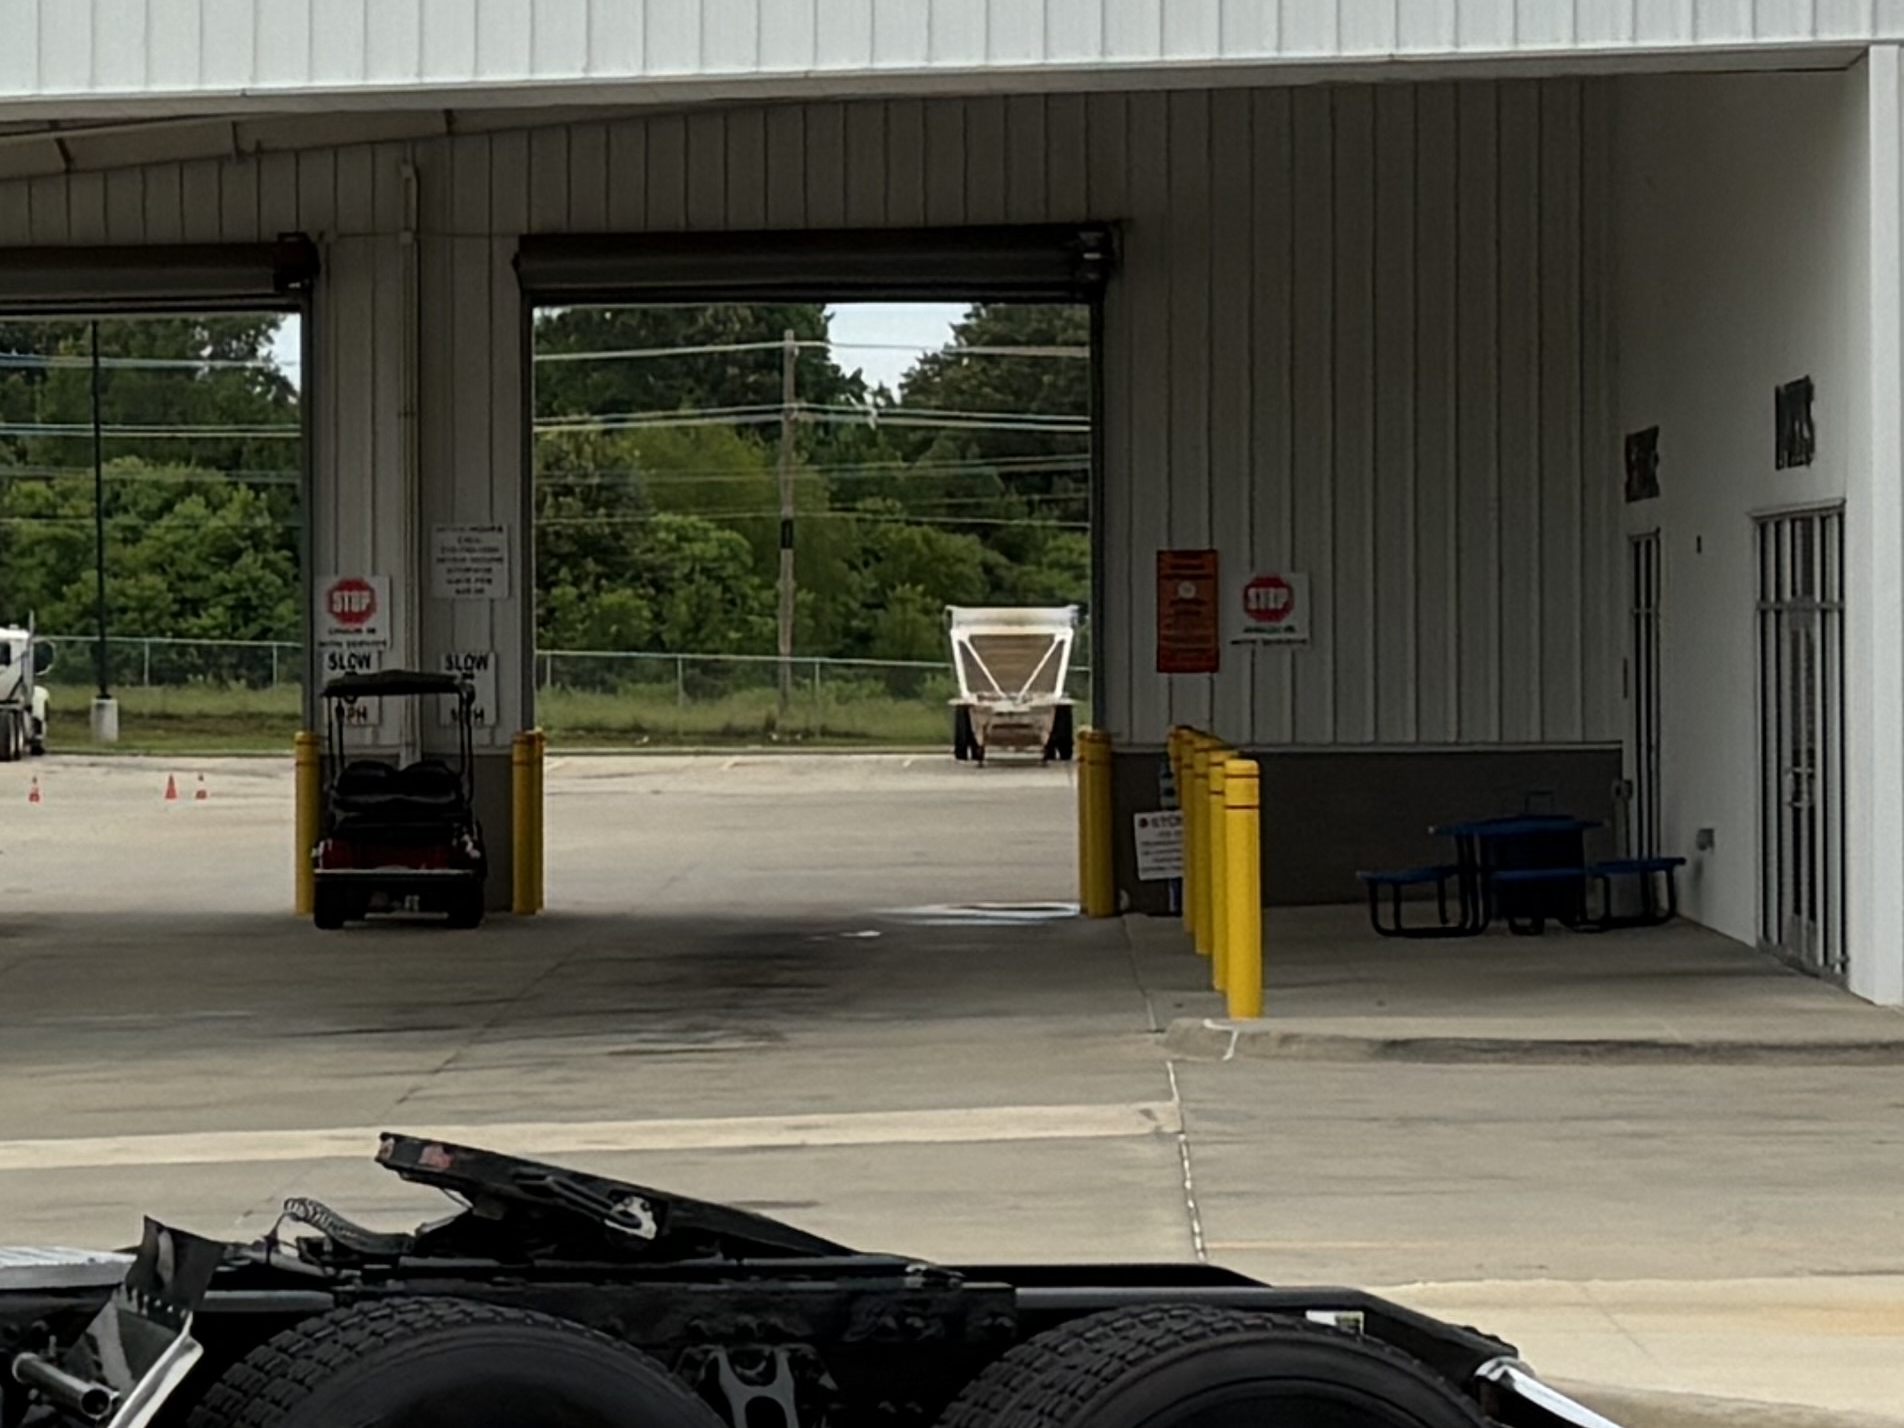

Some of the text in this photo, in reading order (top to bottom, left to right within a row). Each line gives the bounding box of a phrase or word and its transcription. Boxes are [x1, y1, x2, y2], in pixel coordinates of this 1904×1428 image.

[332, 590, 371, 613] STOP
[328, 652, 371, 671] SLOW
[445, 653, 489, 671] SLOW
